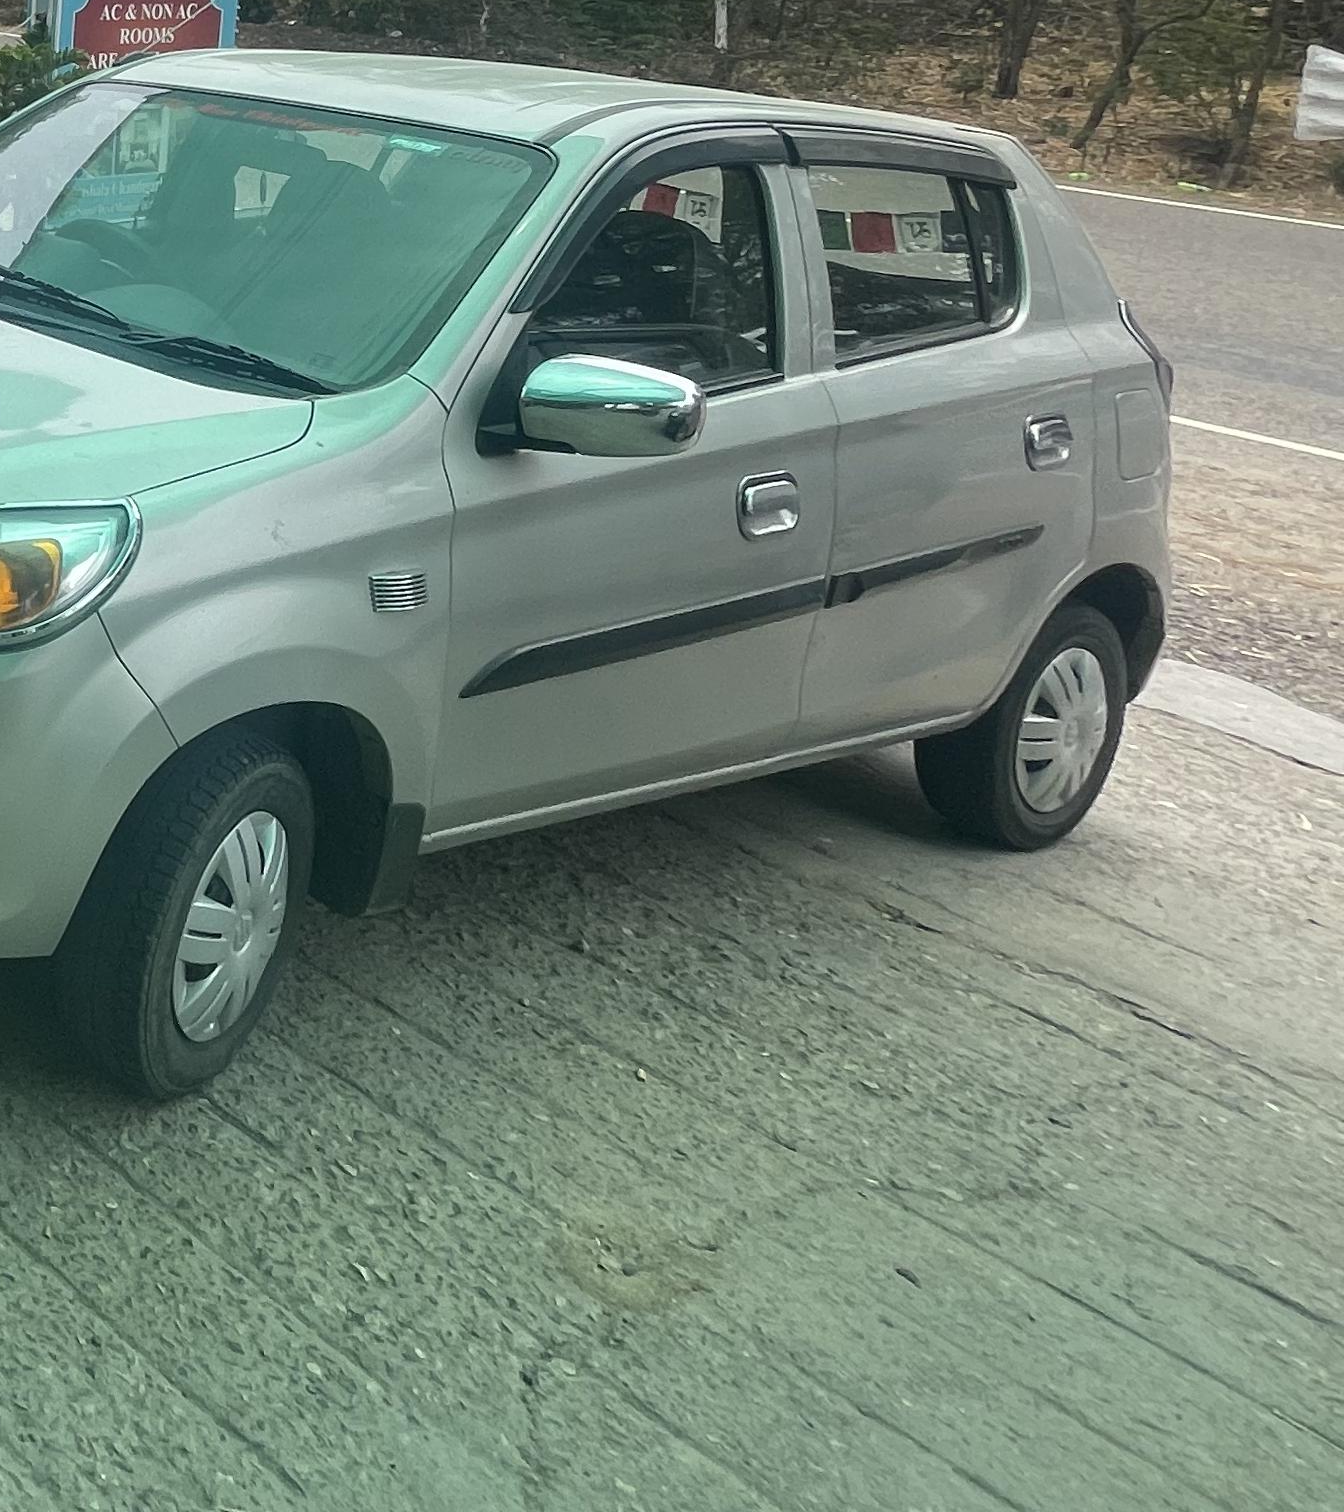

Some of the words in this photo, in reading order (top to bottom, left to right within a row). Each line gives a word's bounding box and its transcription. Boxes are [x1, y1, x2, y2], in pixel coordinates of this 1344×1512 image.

[100, 3, 123, 21] AC
[124, 3, 137, 20] &
[141, 3, 173, 20] NON
[176, 2, 198, 20] AC
[120, 27, 175, 45] ROOMS
